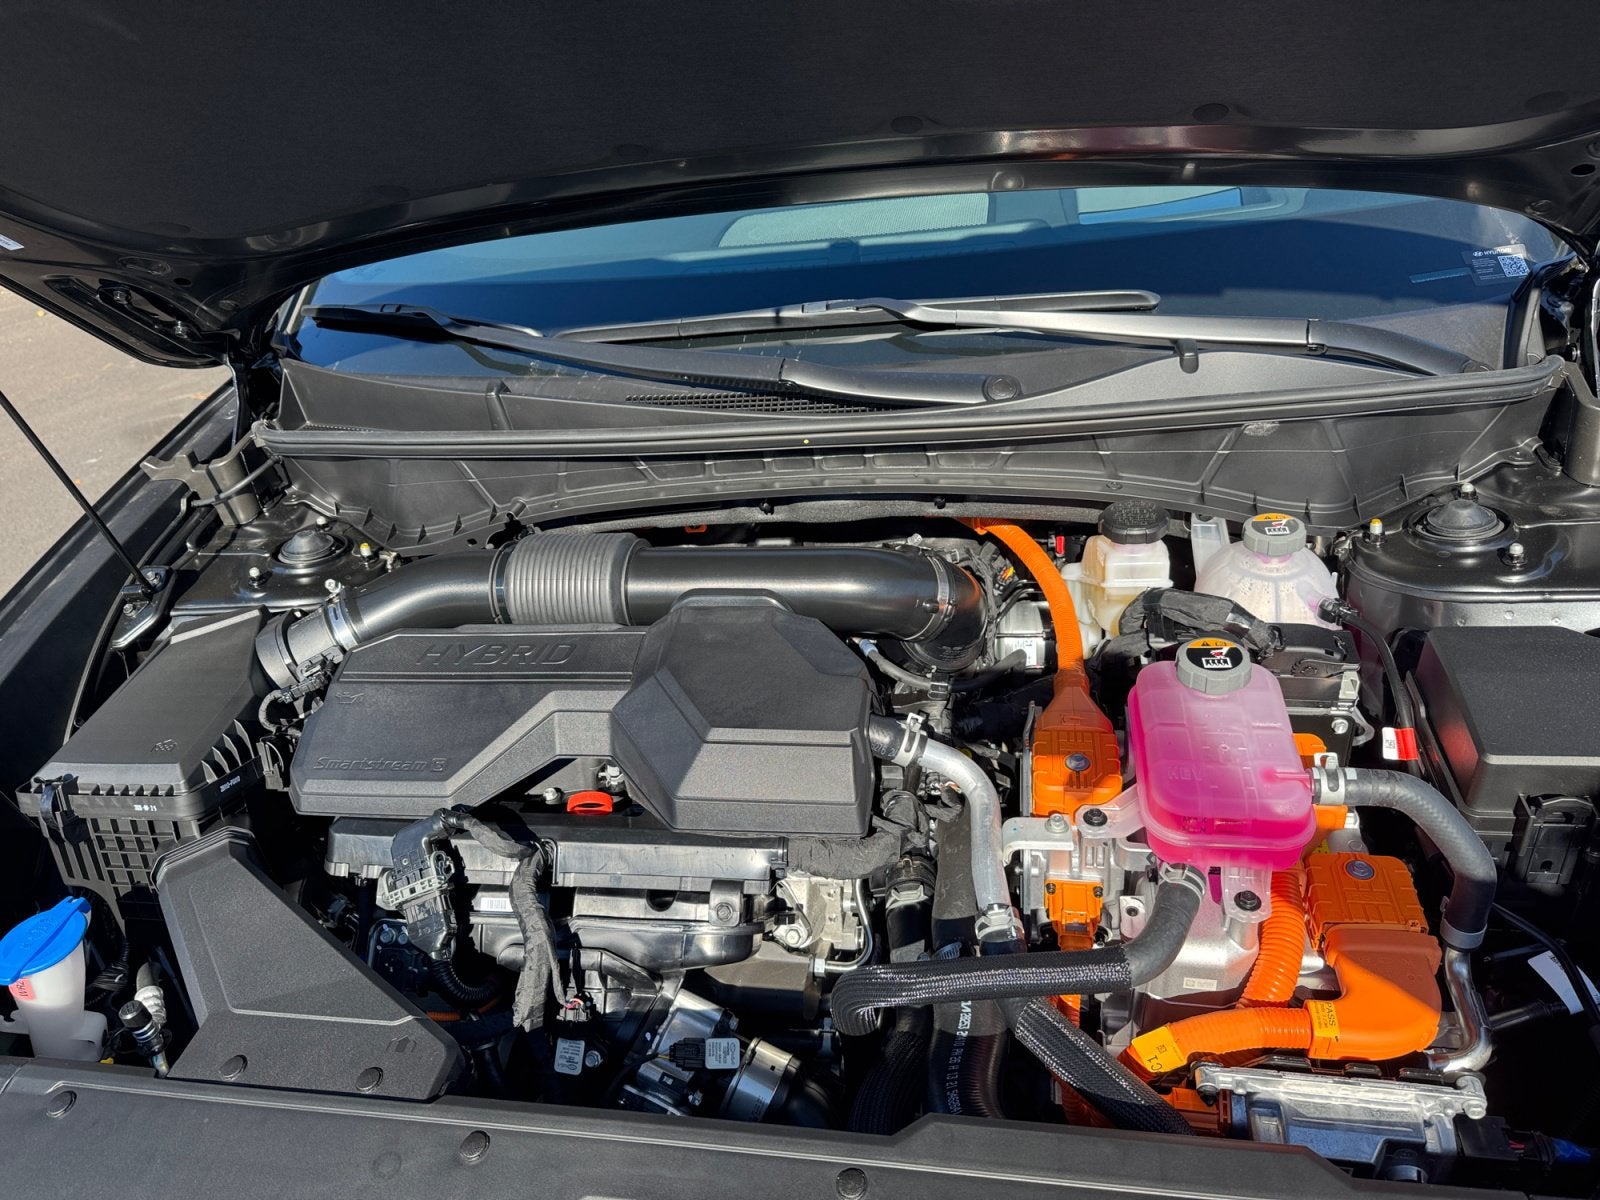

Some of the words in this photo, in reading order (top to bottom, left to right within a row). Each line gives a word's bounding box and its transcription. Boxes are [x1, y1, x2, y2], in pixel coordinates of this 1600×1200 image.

[415, 643, 577, 665] HYBRID
[313, 756, 428, 770] Smartstream
[1326, 1001, 1336, 1027] PASS
